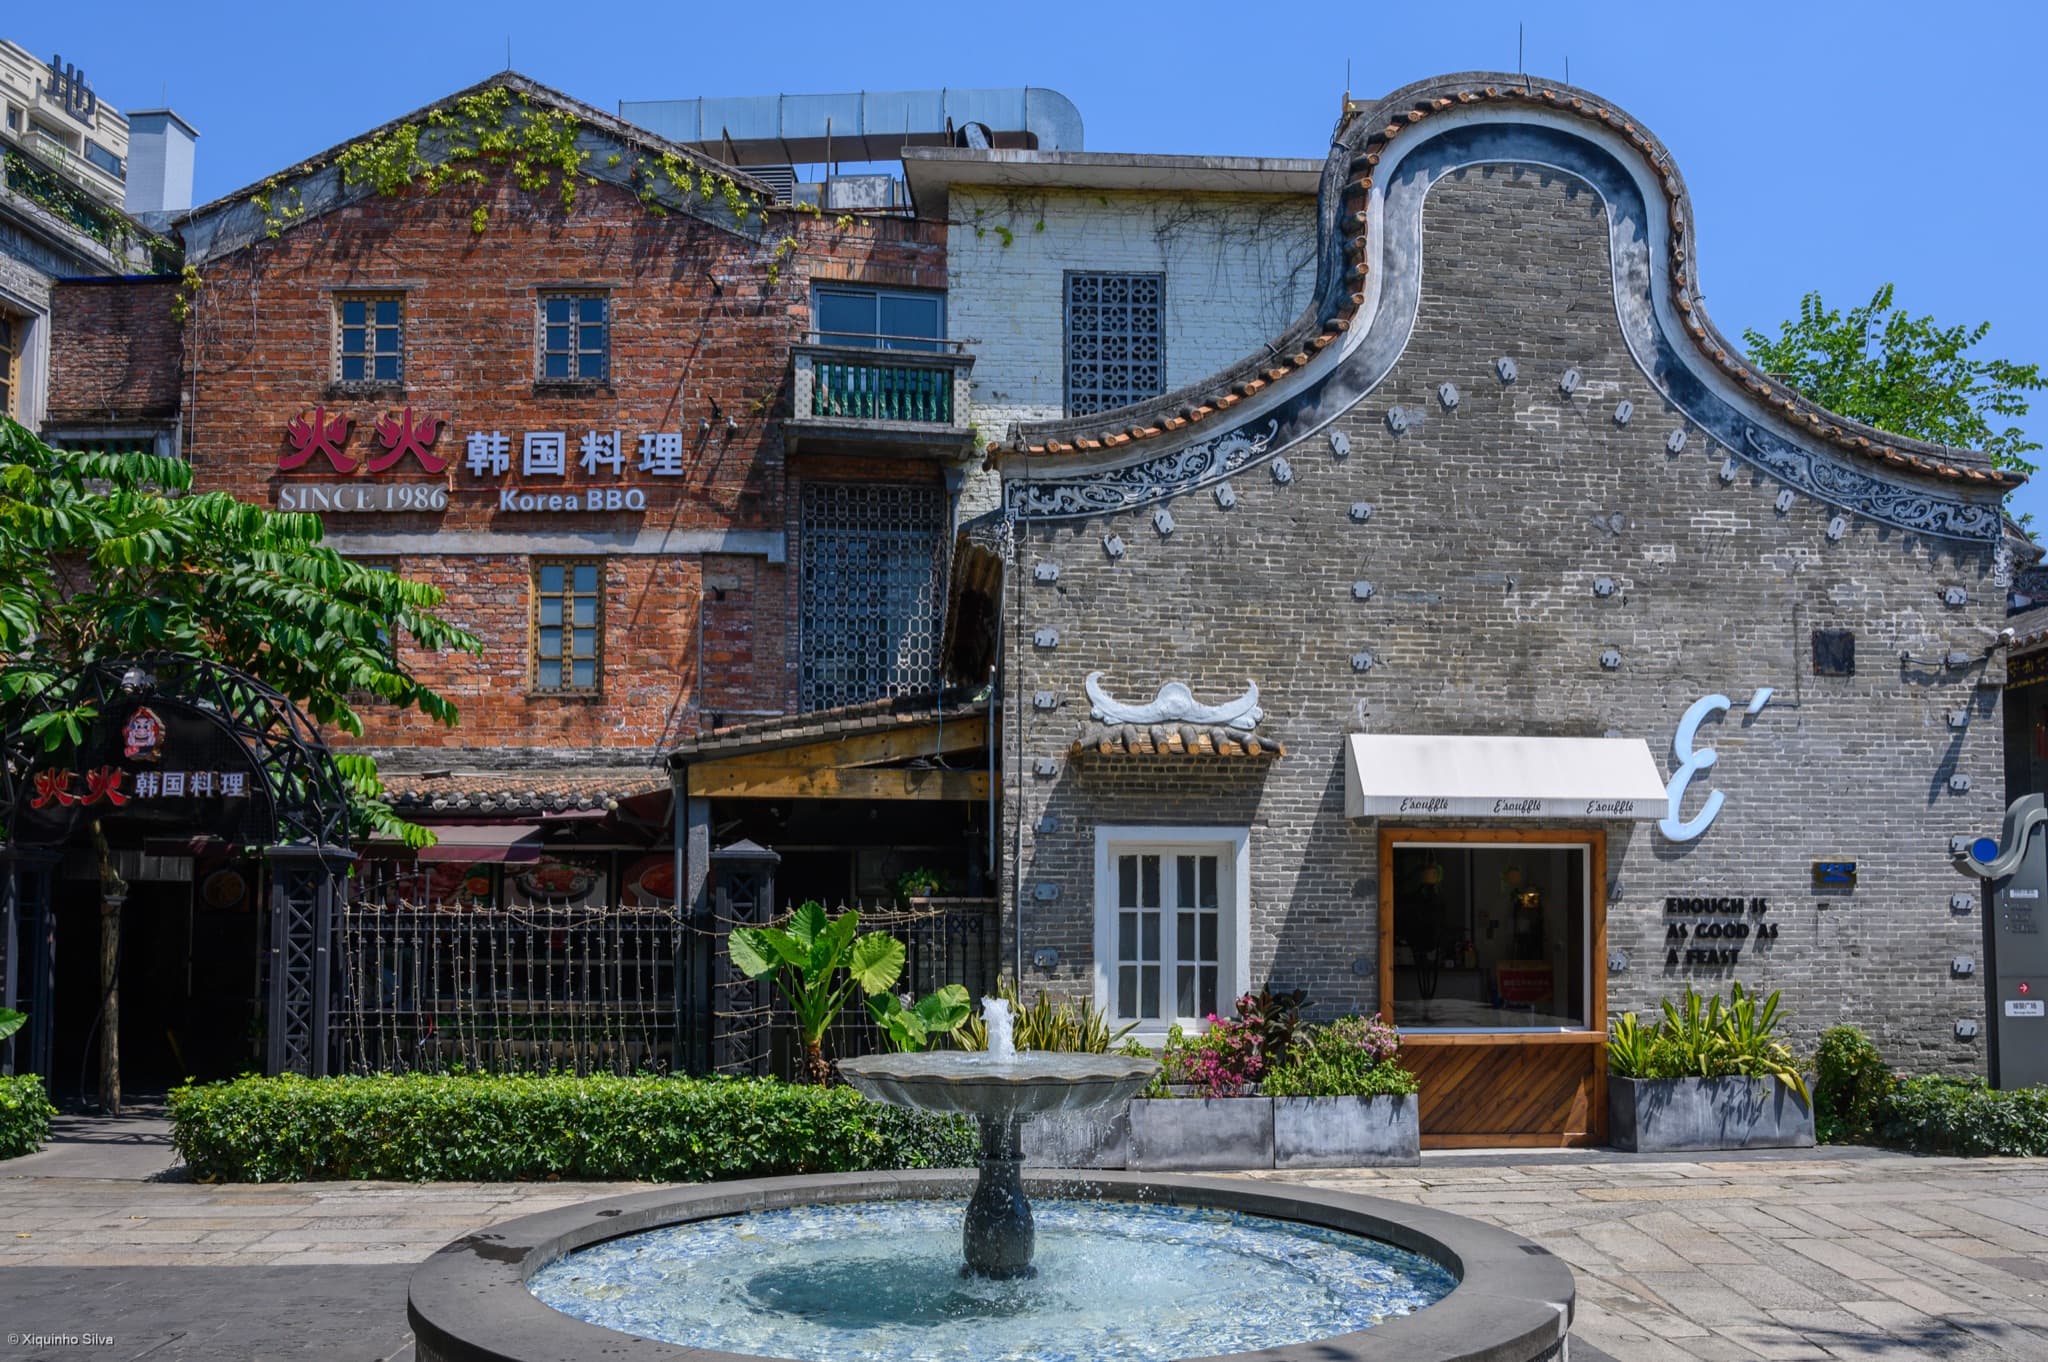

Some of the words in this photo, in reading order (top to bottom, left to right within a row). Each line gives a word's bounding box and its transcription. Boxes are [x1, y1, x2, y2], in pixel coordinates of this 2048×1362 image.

[44, 54, 96, 130] 地
[465, 430, 685, 477] 韩国料理
[279, 486, 376, 511] SINCE
[386, 484, 447, 511] 1986
[500, 489, 579, 512] Korea
[586, 488, 648, 512] BBQ
[135, 771, 246, 798] 韩国料理
[1666, 897, 1745, 914] ENOUGH
[1752, 897, 1768, 914] IS
[1667, 922, 1689, 939] AS
[1694, 922, 1750, 939] GOOD
[1757, 922, 1779, 939] AS
[1666, 948, 1680, 964] A
[1685, 948, 1741, 965] FEAST
